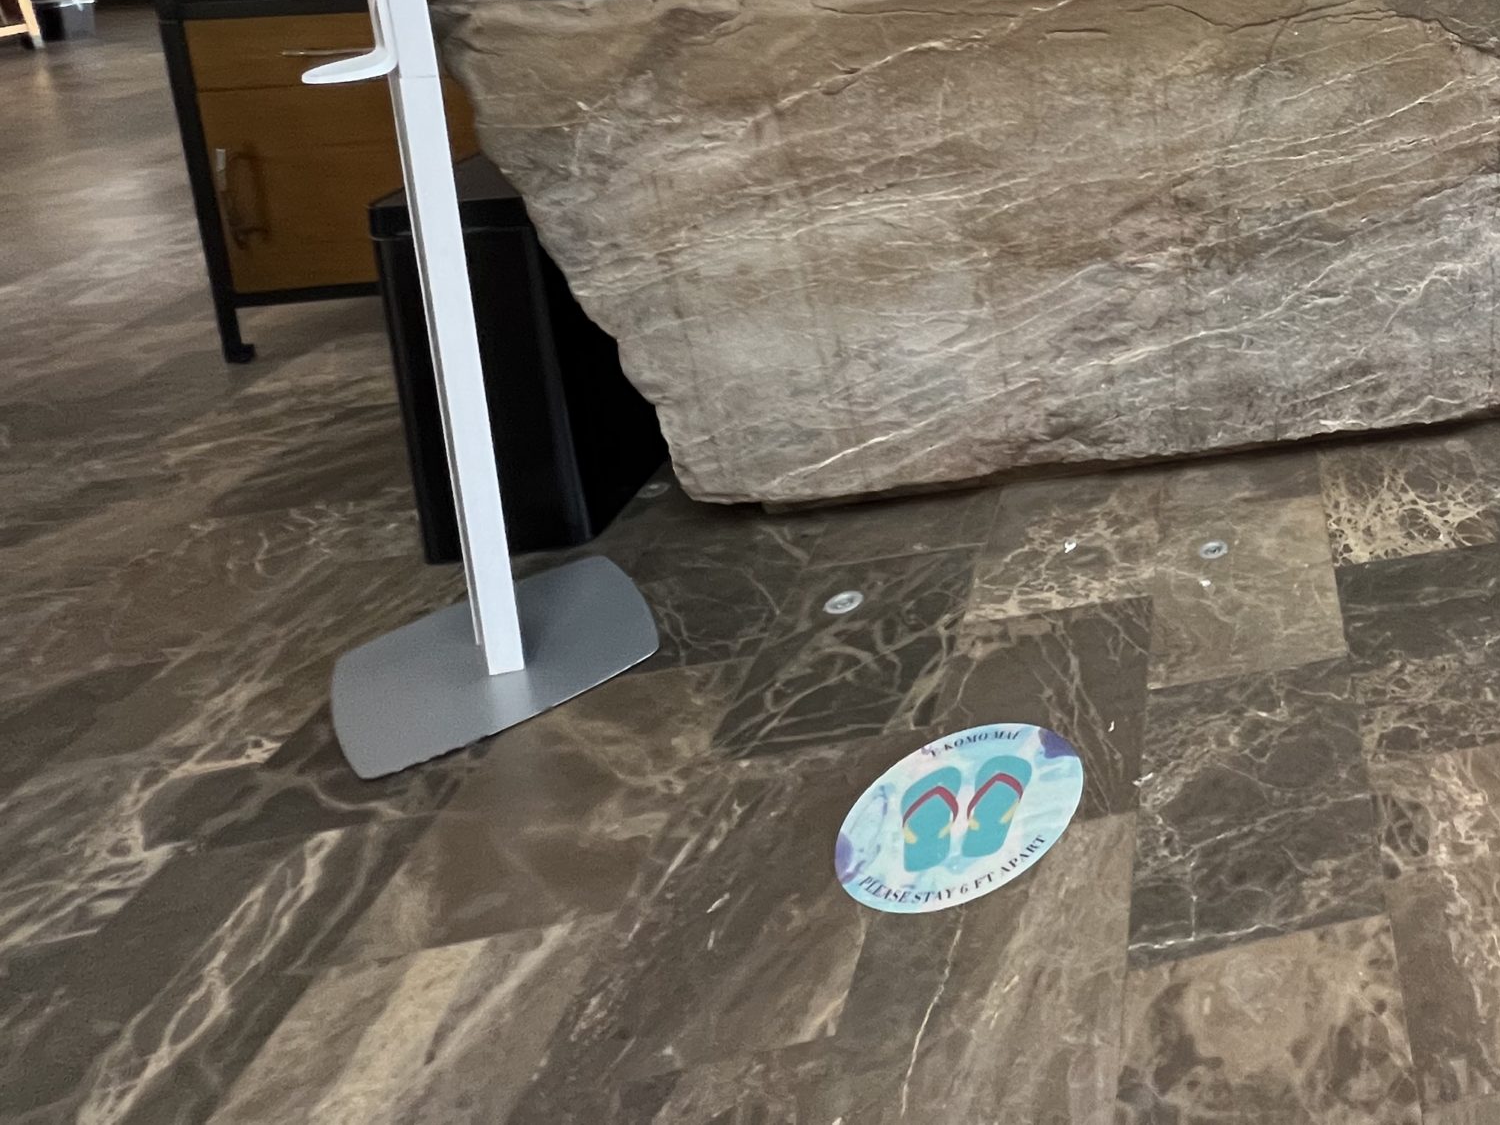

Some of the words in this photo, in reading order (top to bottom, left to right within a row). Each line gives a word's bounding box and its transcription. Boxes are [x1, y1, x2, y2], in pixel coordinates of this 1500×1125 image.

[859, 876, 911, 903] PLEASE
[912, 889, 954, 903] STAY
[959, 885, 968, 894] 6
[974, 872, 994, 889] FT
[1000, 835, 1045, 874] APART
